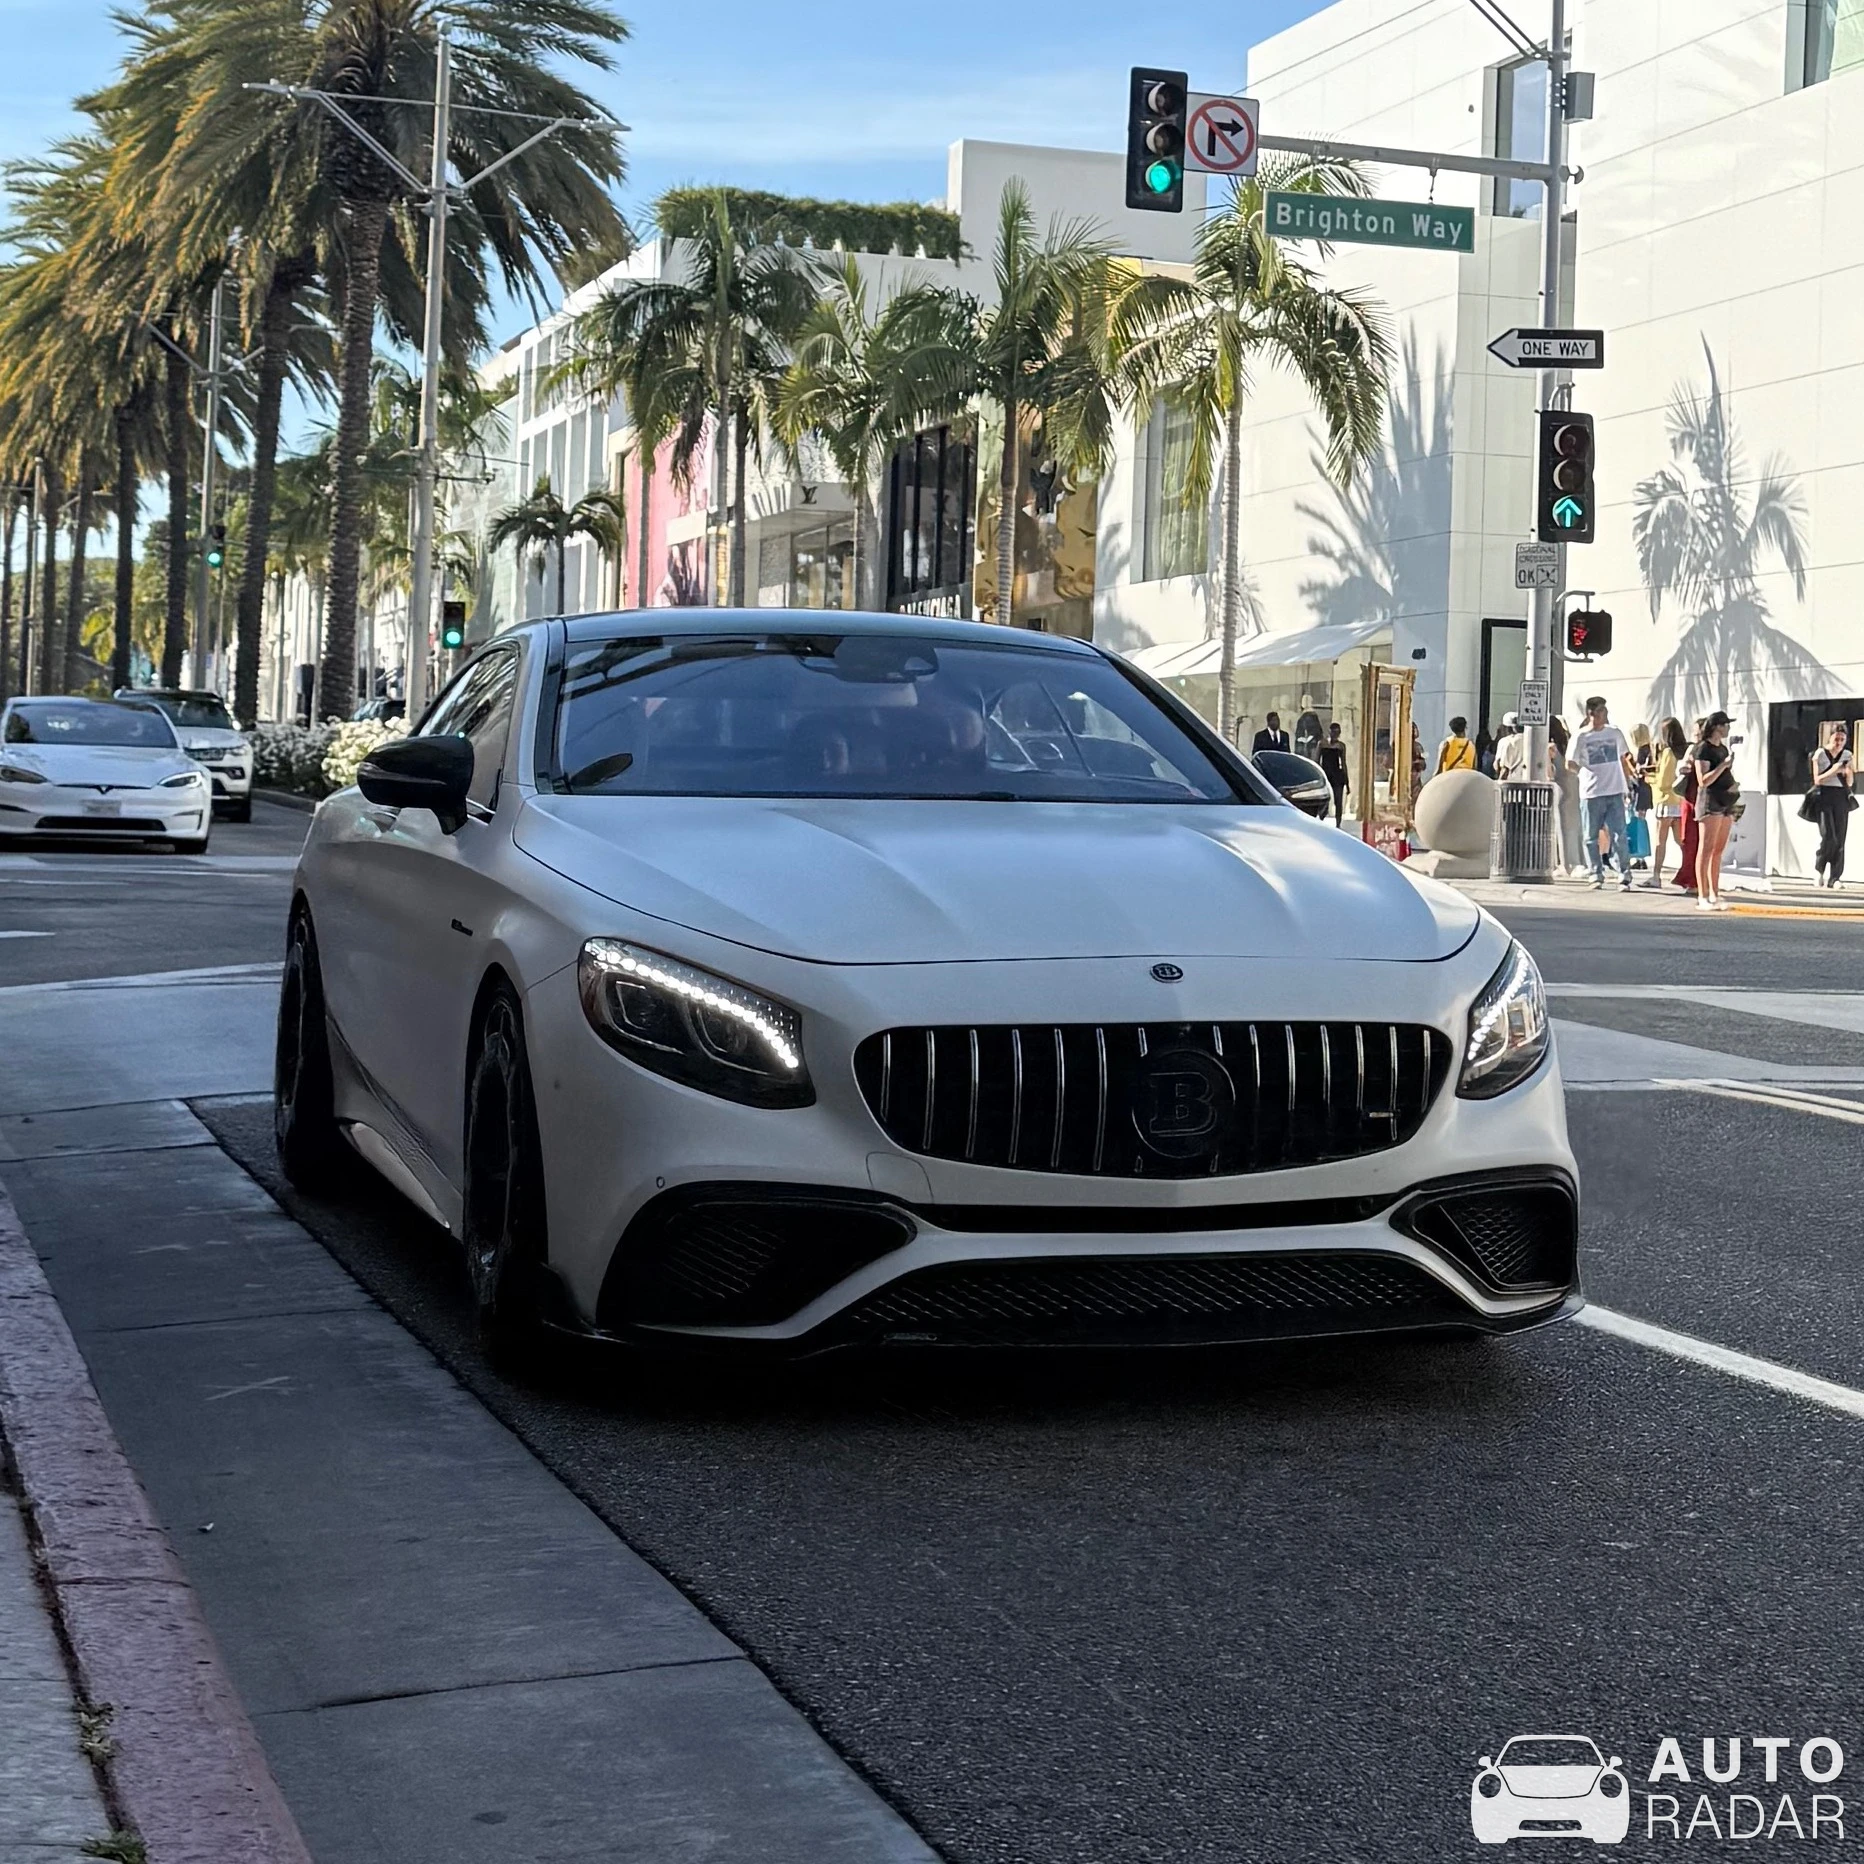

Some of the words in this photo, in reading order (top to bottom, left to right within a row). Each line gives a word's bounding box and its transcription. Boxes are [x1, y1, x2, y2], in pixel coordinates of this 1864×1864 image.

[1276, 202, 1396, 237] Brighton
[1412, 213, 1463, 246] Way
[1522, 341, 1552, 356] ONE
[1559, 342, 1589, 357] WAY
[1518, 569, 1535, 584] OK
